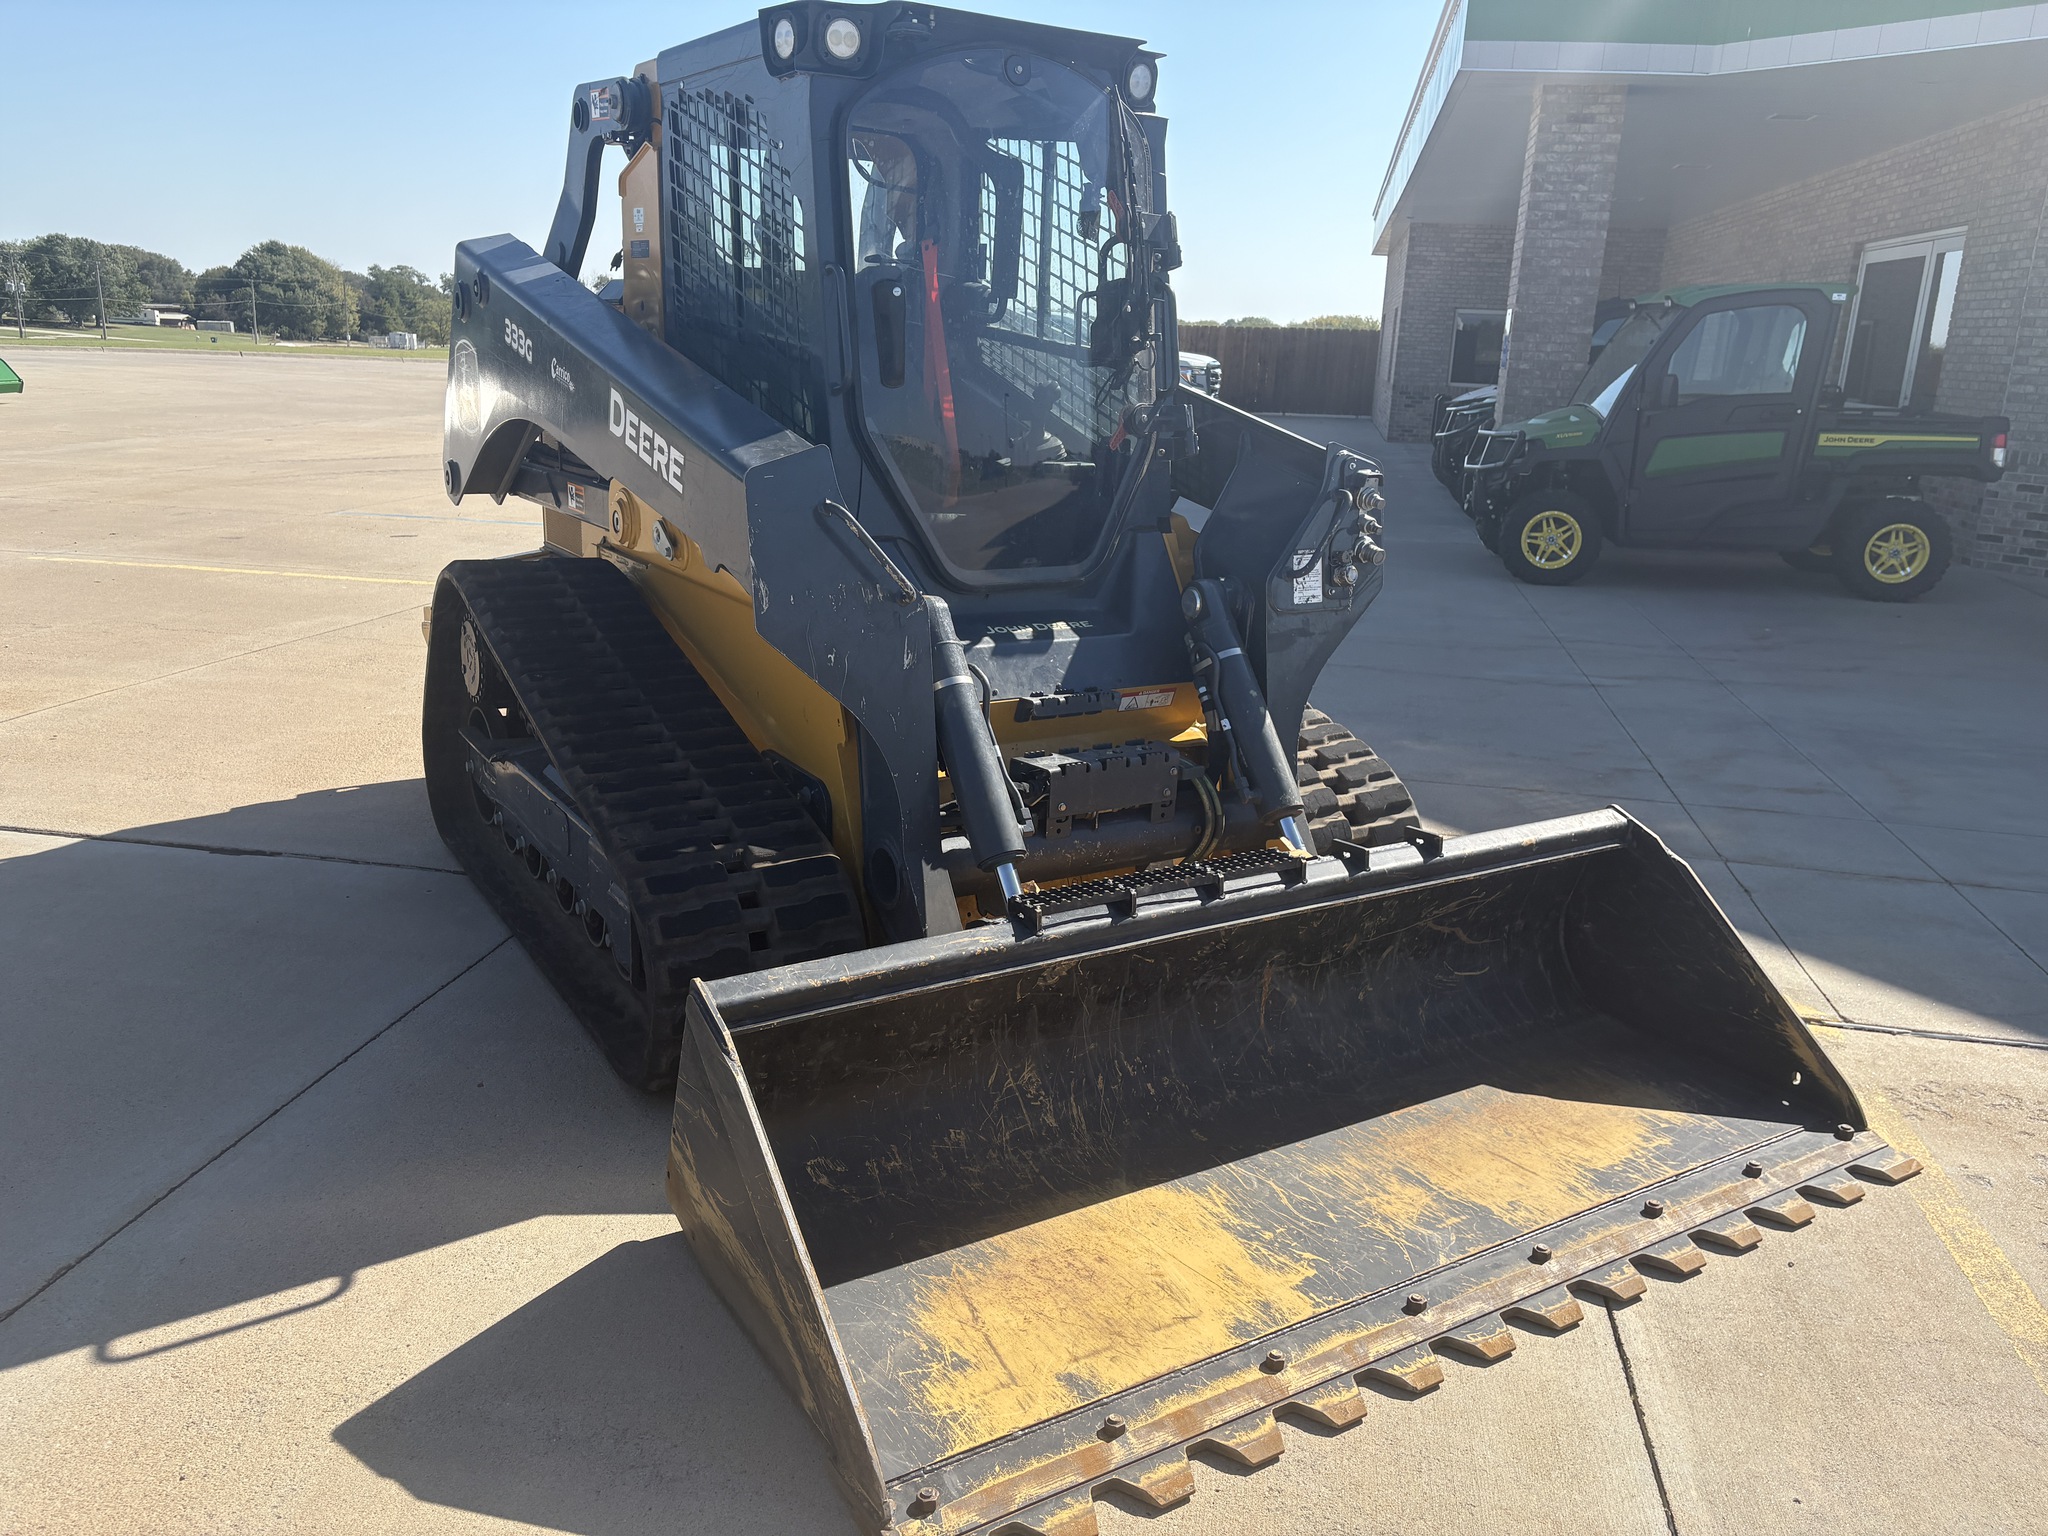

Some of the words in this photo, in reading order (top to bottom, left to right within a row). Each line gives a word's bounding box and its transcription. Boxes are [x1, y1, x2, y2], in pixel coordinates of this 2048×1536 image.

[504, 317, 533, 364] 333G
[551, 357, 571, 383] Carrico
[609, 386, 685, 495] DEERE
[1823, 435, 1846, 443] JOHN
[1847, 436, 1876, 444] DEERE
[986, 624, 1033, 635] JOHN
[1033, 620, 1094, 631] DEERE
